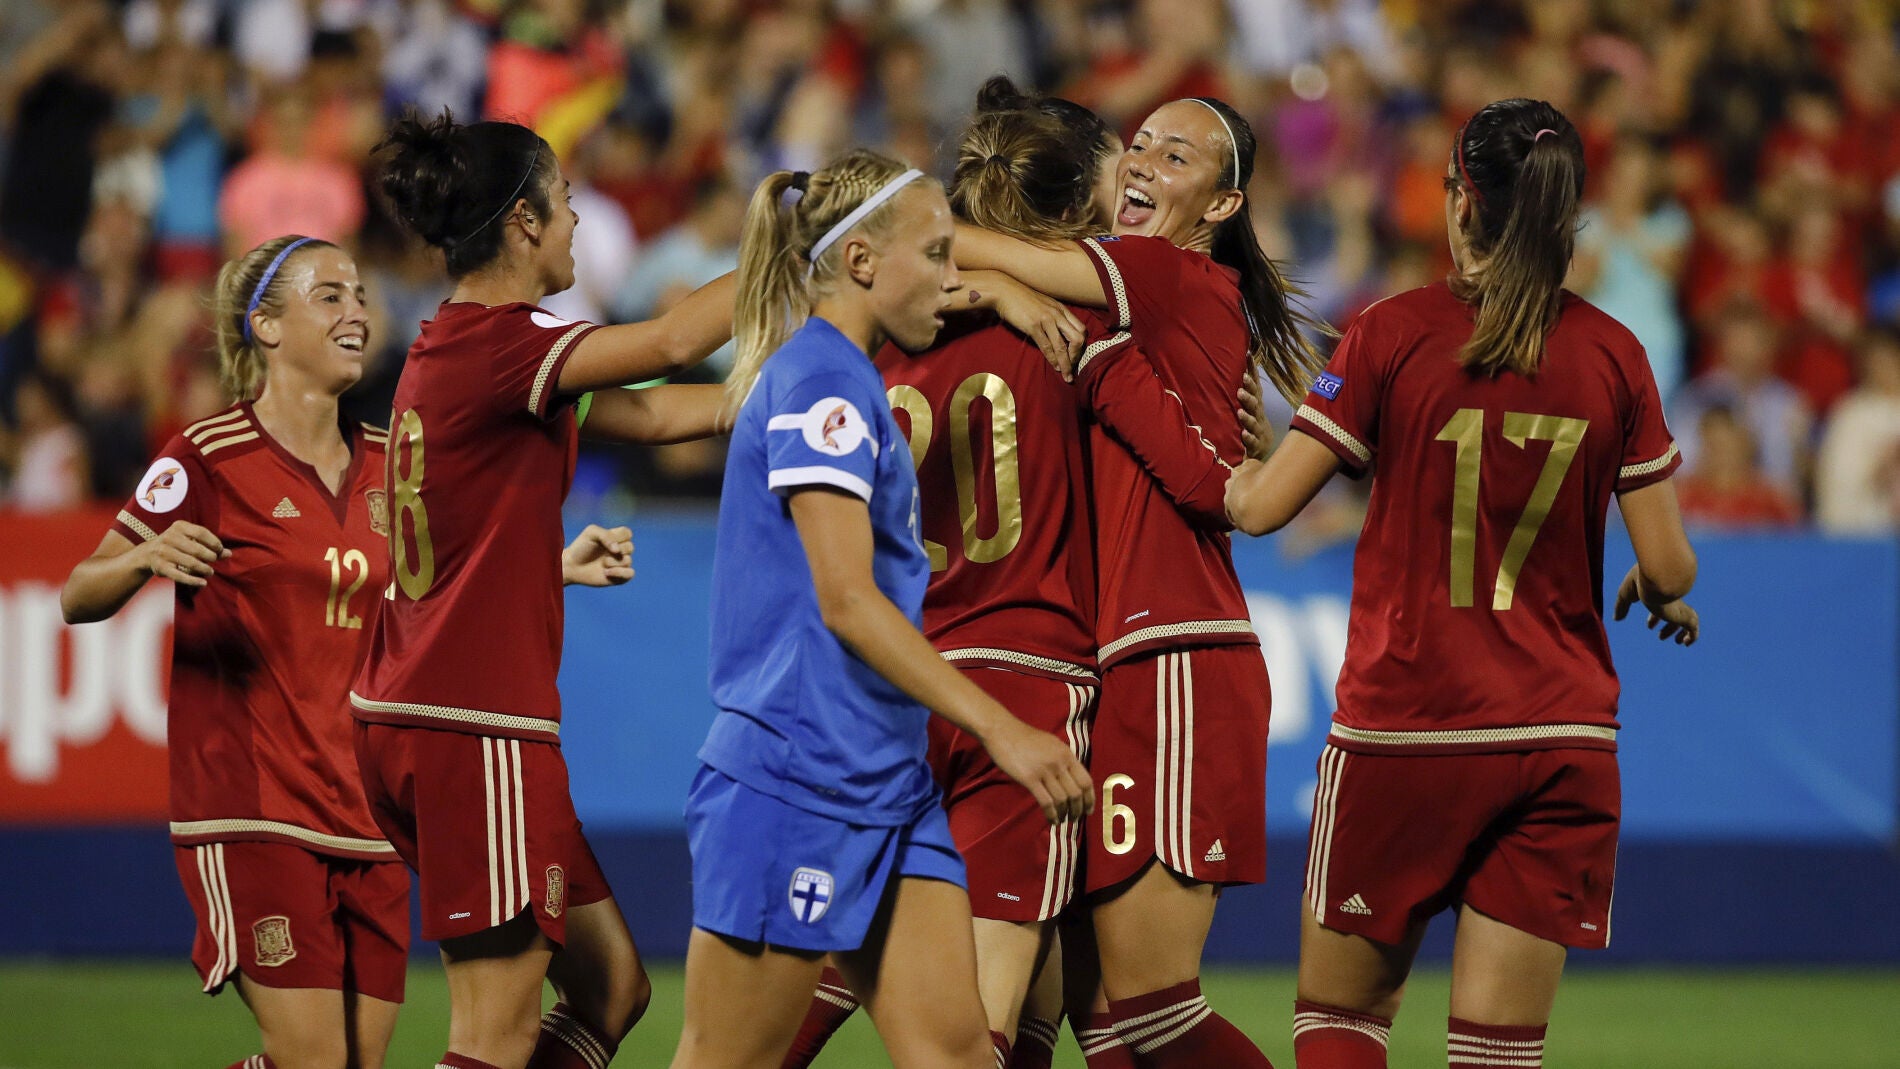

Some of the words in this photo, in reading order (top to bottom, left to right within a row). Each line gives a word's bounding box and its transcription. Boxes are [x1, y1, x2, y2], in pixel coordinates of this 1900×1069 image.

[385, 408, 434, 600] 8
[1434, 408, 1590, 611] 17
[324, 547, 369, 629] 12
[1103, 773, 1136, 855] 6
